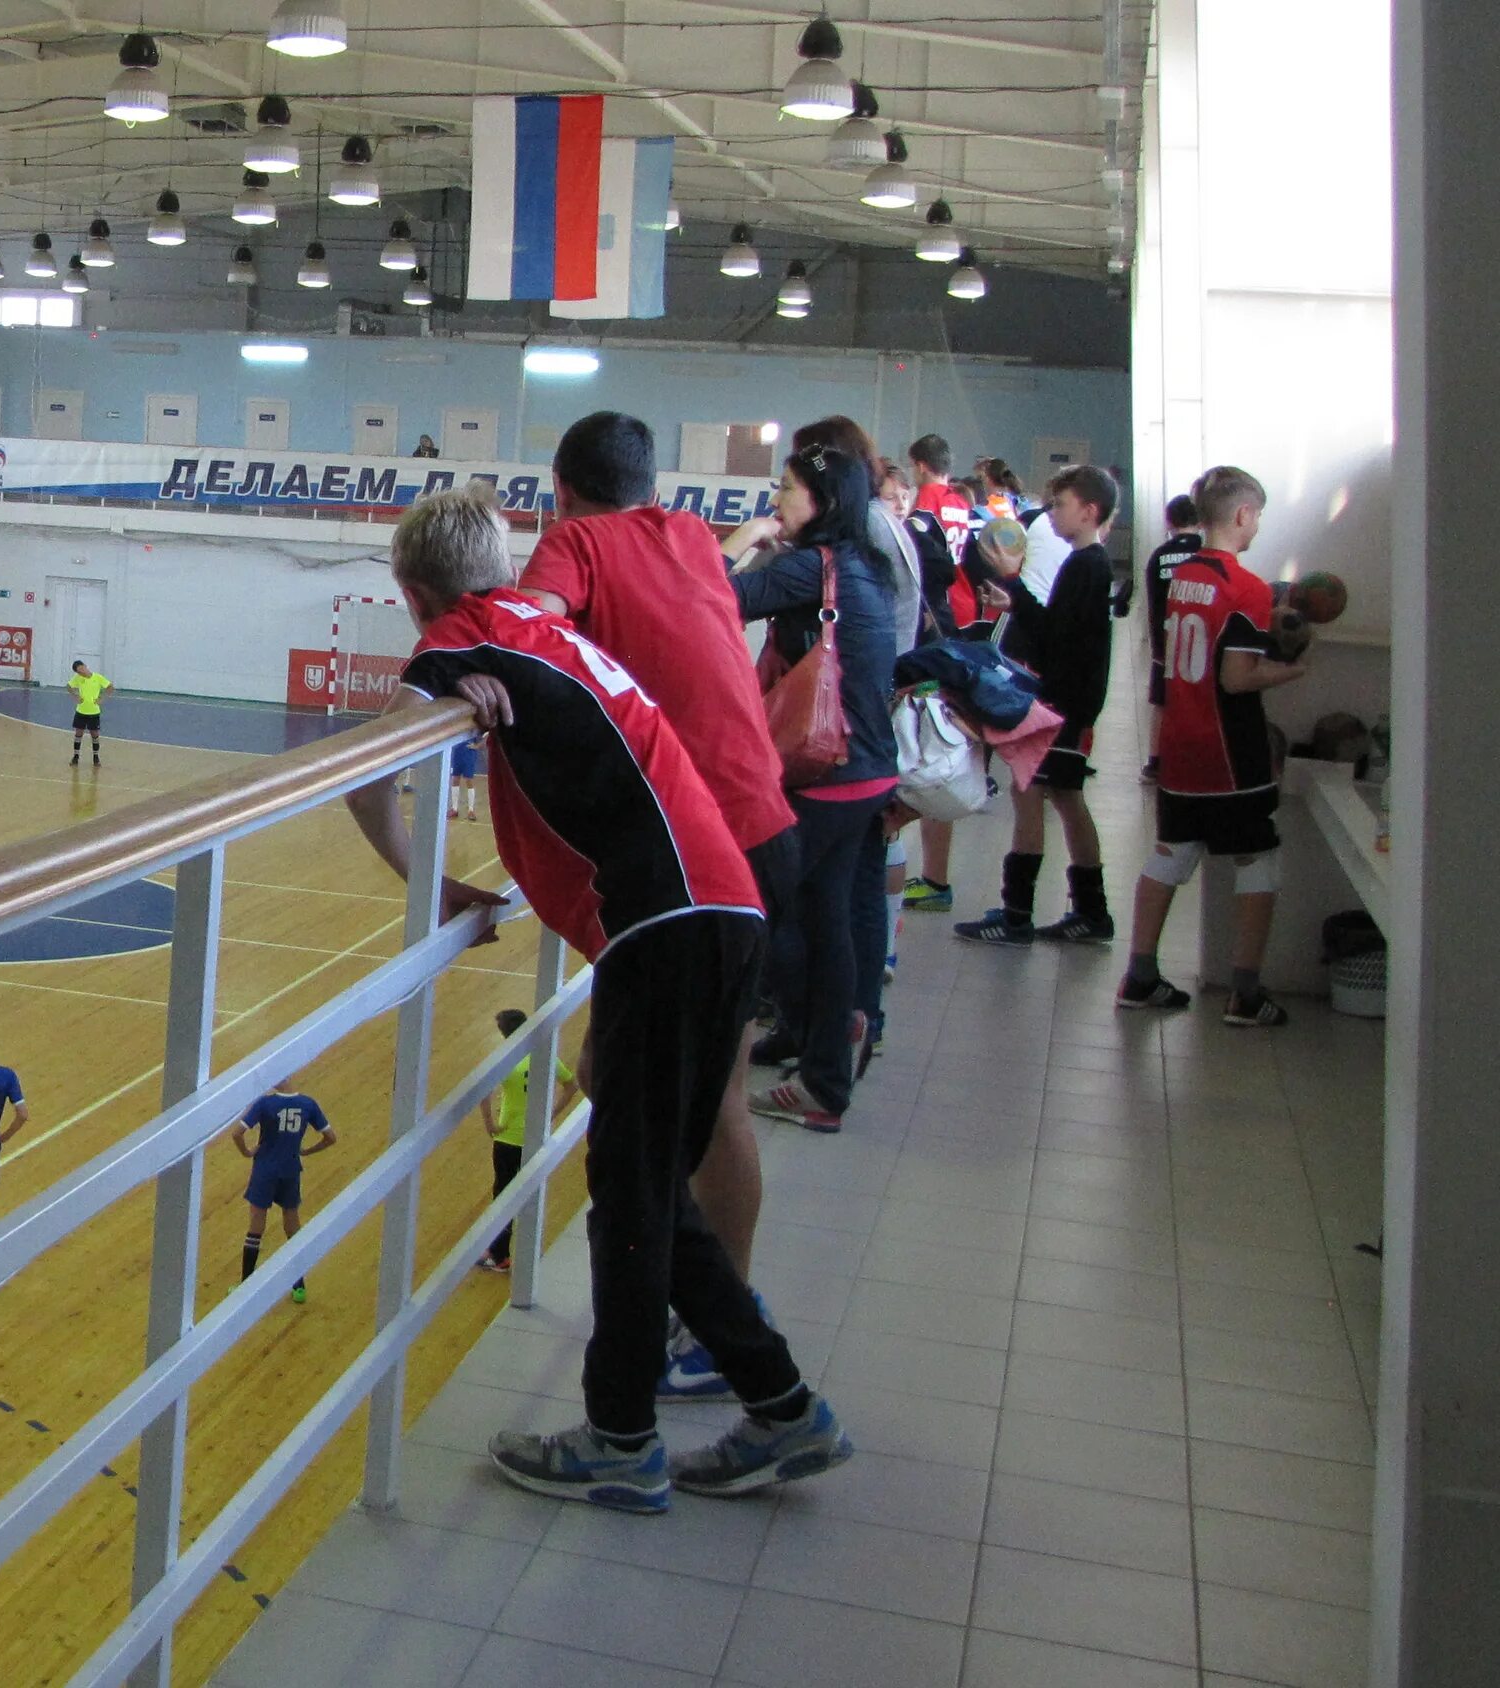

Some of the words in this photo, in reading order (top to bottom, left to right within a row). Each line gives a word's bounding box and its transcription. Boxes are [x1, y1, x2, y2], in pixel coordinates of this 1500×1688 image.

[161, 458, 398, 500] ДЕЛАЕМ
[1163, 612, 1207, 684] 10
[276, 1108, 302, 1132] 15
